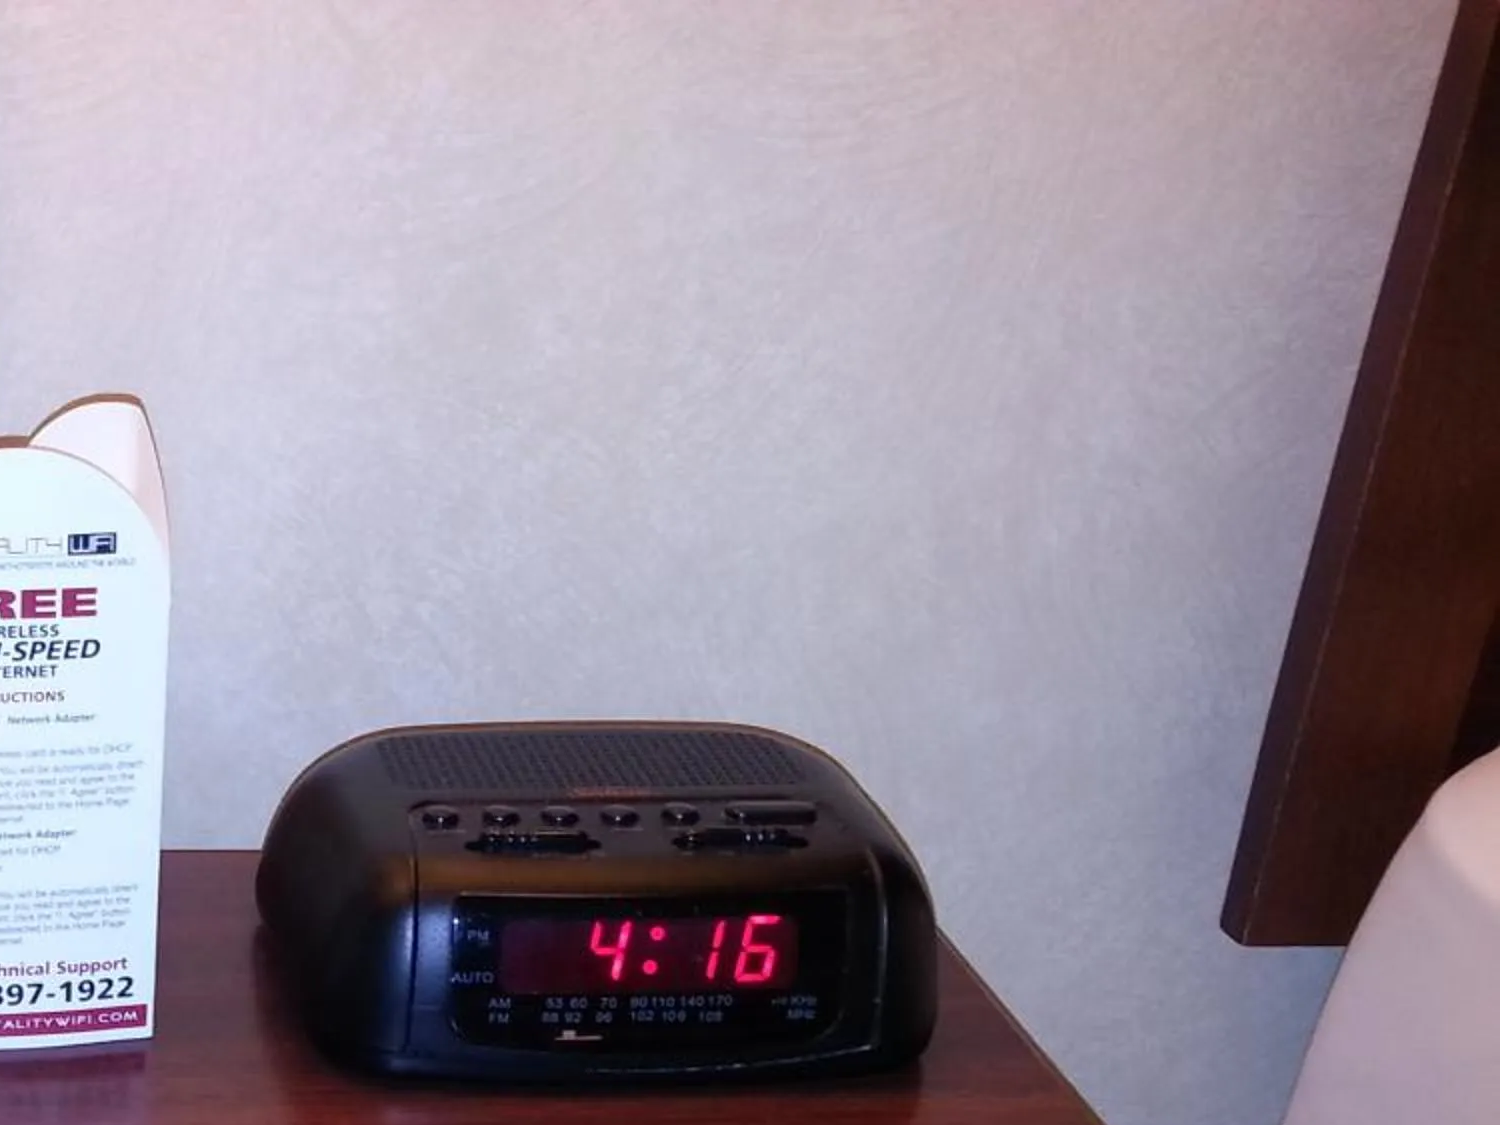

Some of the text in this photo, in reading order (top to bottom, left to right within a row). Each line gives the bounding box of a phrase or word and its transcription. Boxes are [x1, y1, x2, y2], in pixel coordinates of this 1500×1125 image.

[7, 714, 51, 724] Network
[55, 712, 97, 724] Adapter
[36, 828, 80, 841] Adapter
[466, 929, 489, 941] PM
[590, 914, 783, 983] 4:16
[57, 956, 129, 977] Support
[450, 971, 495, 984] AUTO
[488, 997, 511, 1009] AM
[599, 996, 618, 1009] 70
[488, 1012, 510, 1024] FM
